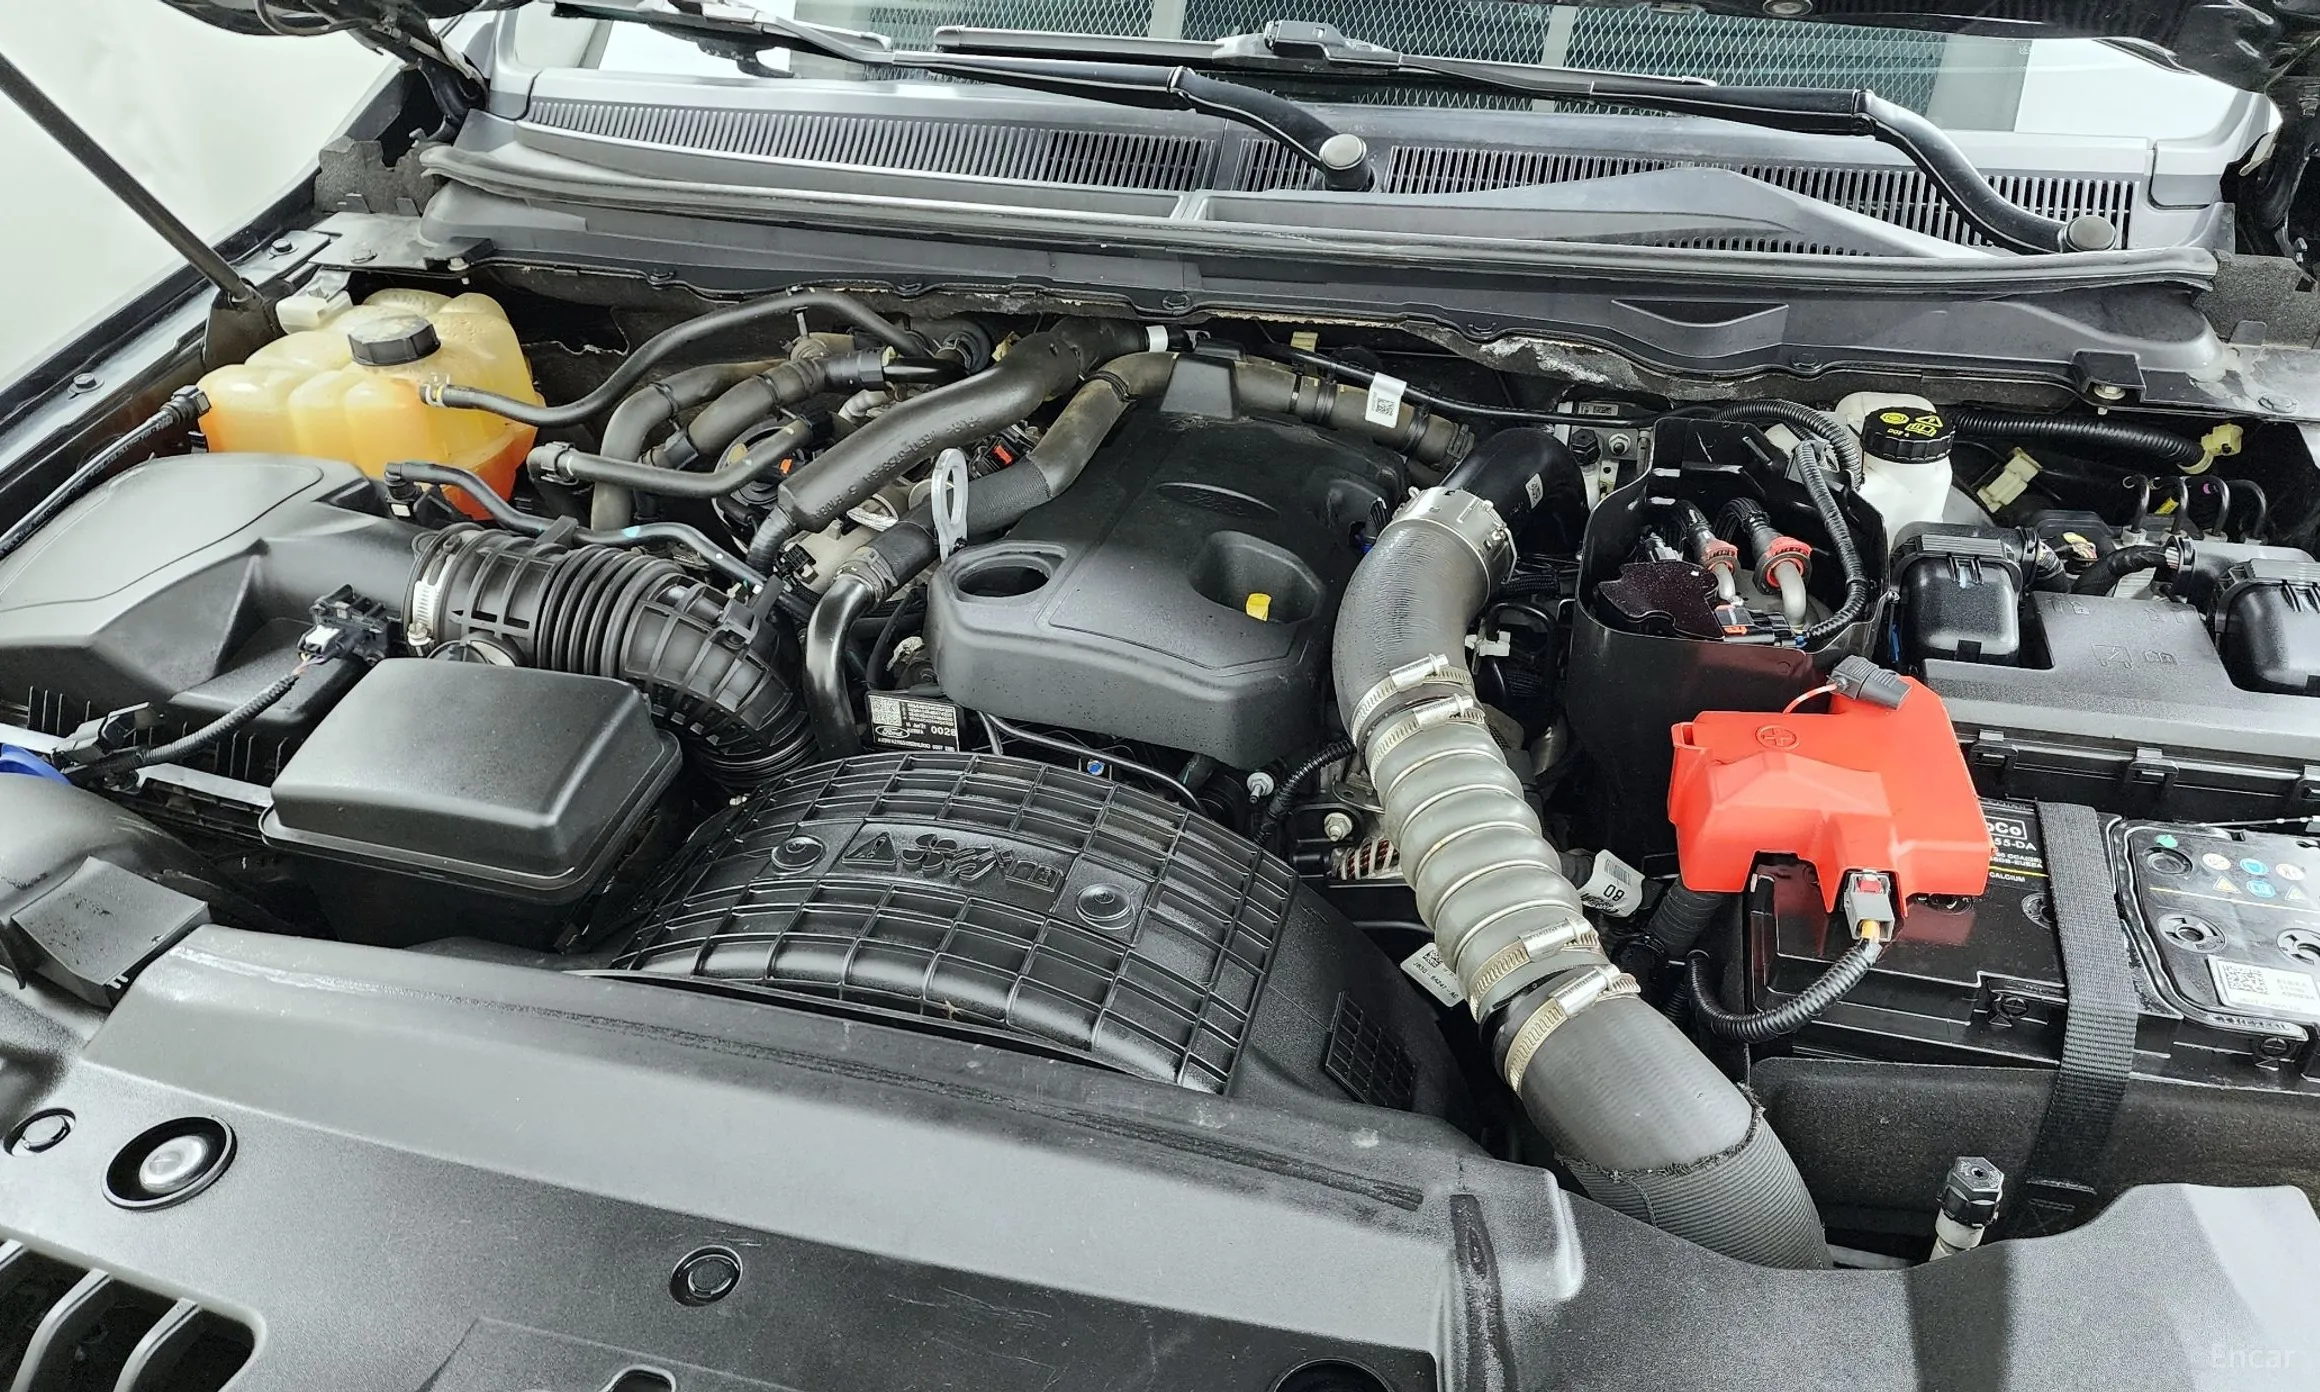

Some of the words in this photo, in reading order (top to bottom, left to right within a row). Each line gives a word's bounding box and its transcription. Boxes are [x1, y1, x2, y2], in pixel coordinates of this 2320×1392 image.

[880, 727, 906, 737] Ford
[1986, 821, 2023, 837] oCo
[1994, 837, 2037, 852] 55-DA
[1989, 872, 2026, 882] CALCIUM
